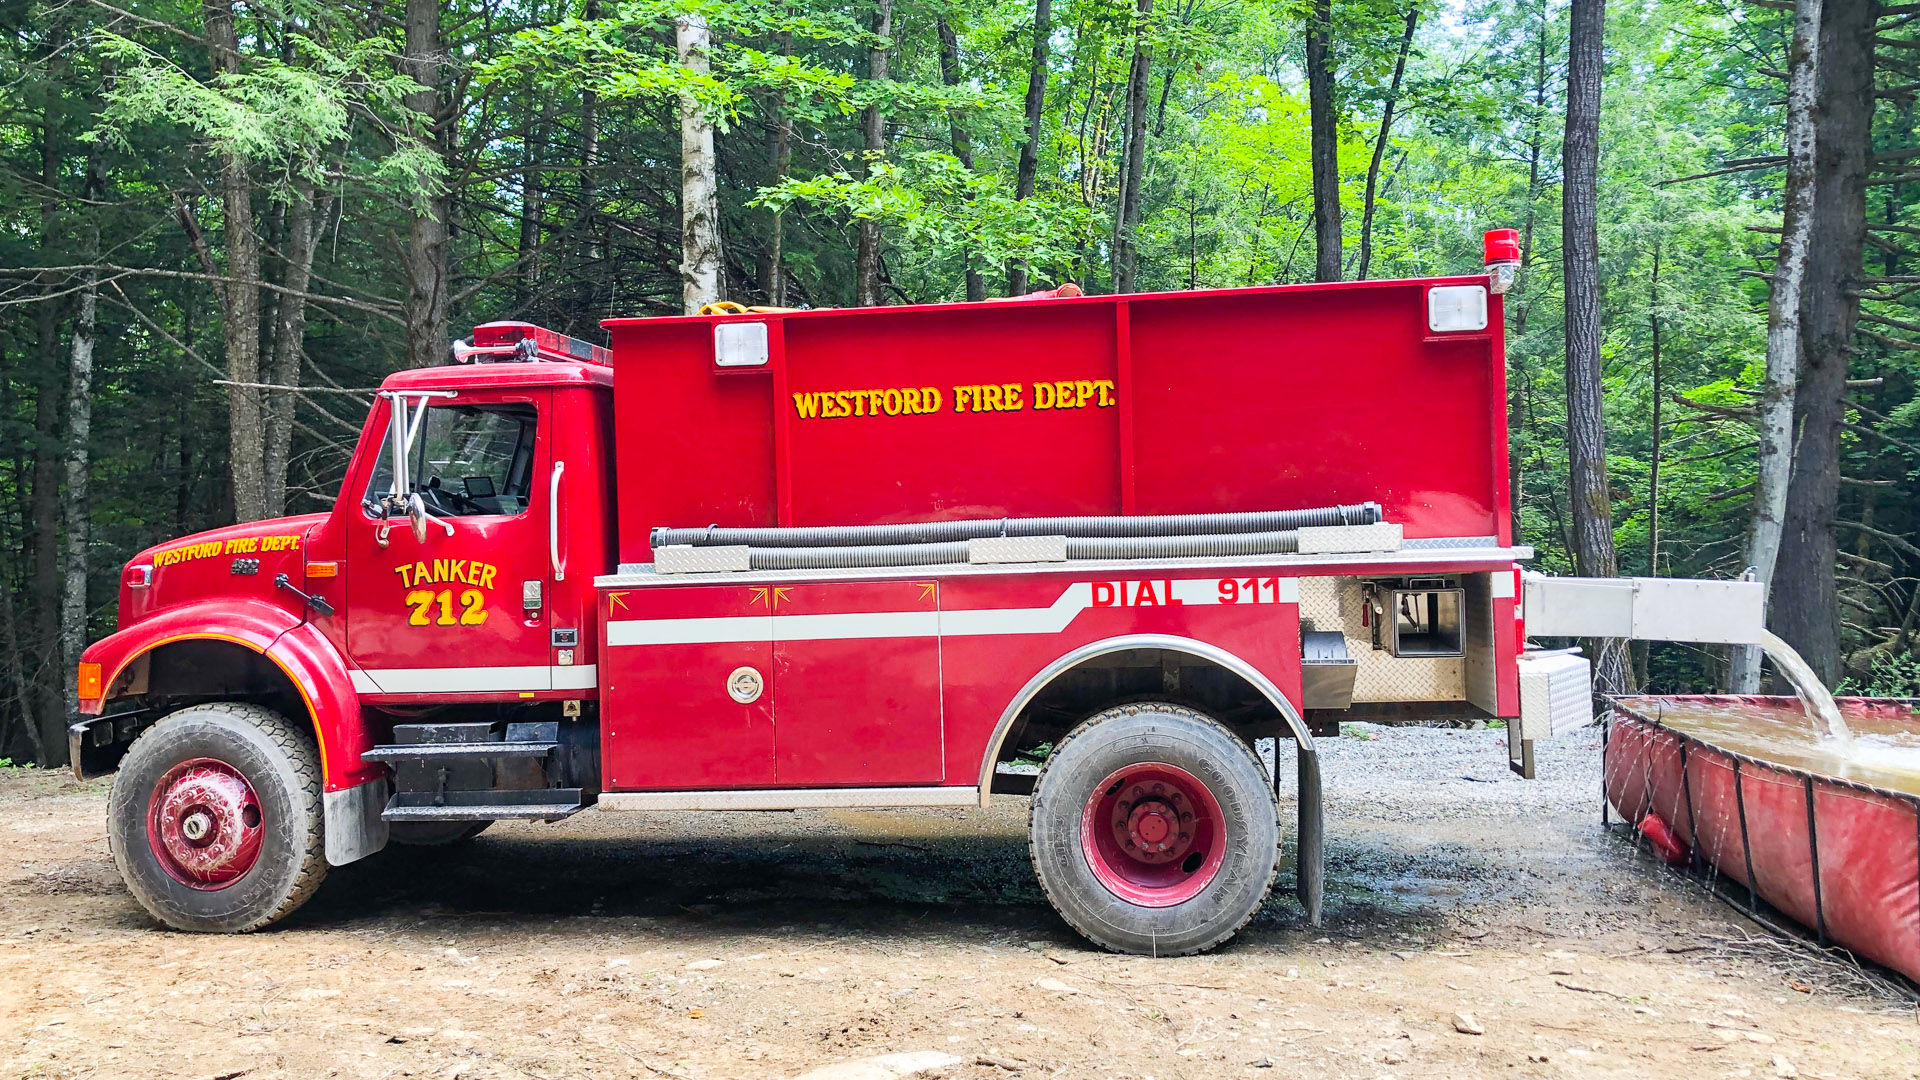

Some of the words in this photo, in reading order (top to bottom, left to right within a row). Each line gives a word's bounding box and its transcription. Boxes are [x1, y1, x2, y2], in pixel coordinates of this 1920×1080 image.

[793, 387, 943, 420] WESTFORD
[953, 383, 1024, 413] FIRE
[1032, 380, 1116, 411] DEPT.
[153, 541, 223, 569] WESTFORD
[224, 537, 259, 555] FIRE
[260, 535, 301, 552] DEPT.
[394, 559, 498, 590] TANKER
[1091, 580, 1183, 608] DIAL
[1217, 577, 1280, 605] 911
[405, 589, 489, 627] 712
[1199, 757, 1249, 905] GOODYEAR
